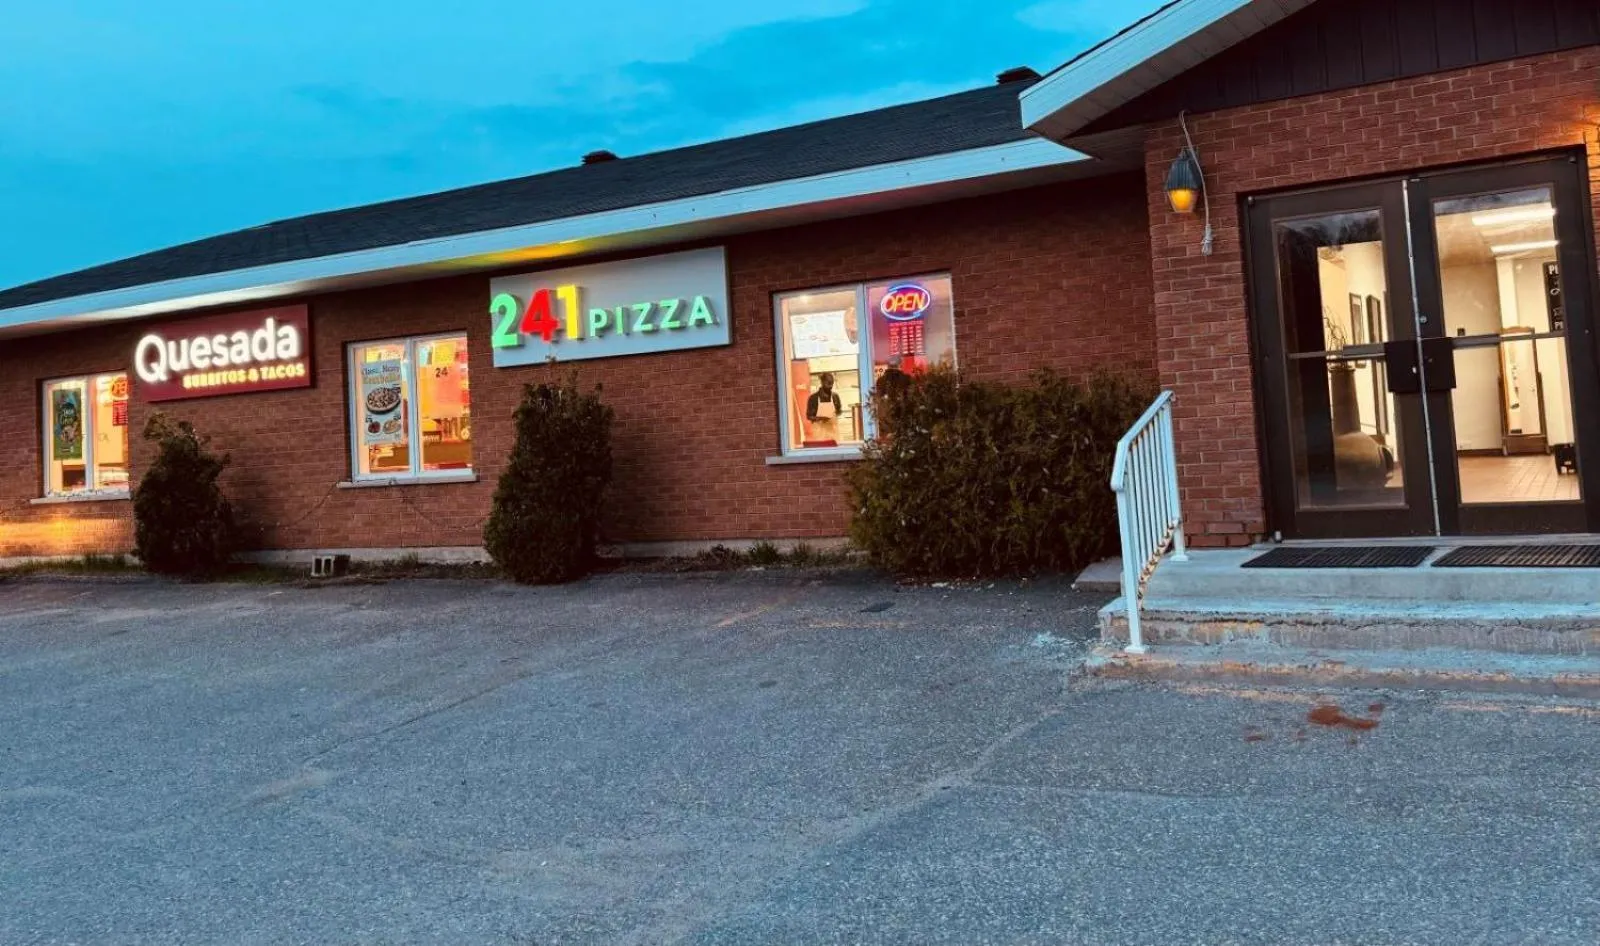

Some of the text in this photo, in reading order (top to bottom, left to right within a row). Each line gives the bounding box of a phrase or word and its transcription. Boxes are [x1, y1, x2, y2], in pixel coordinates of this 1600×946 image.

[490, 284, 713, 349] 241 PIZZA
[883, 292, 926, 313] OPEN
[135, 316, 300, 383] Quesada
[260, 363, 305, 380] TACOS
